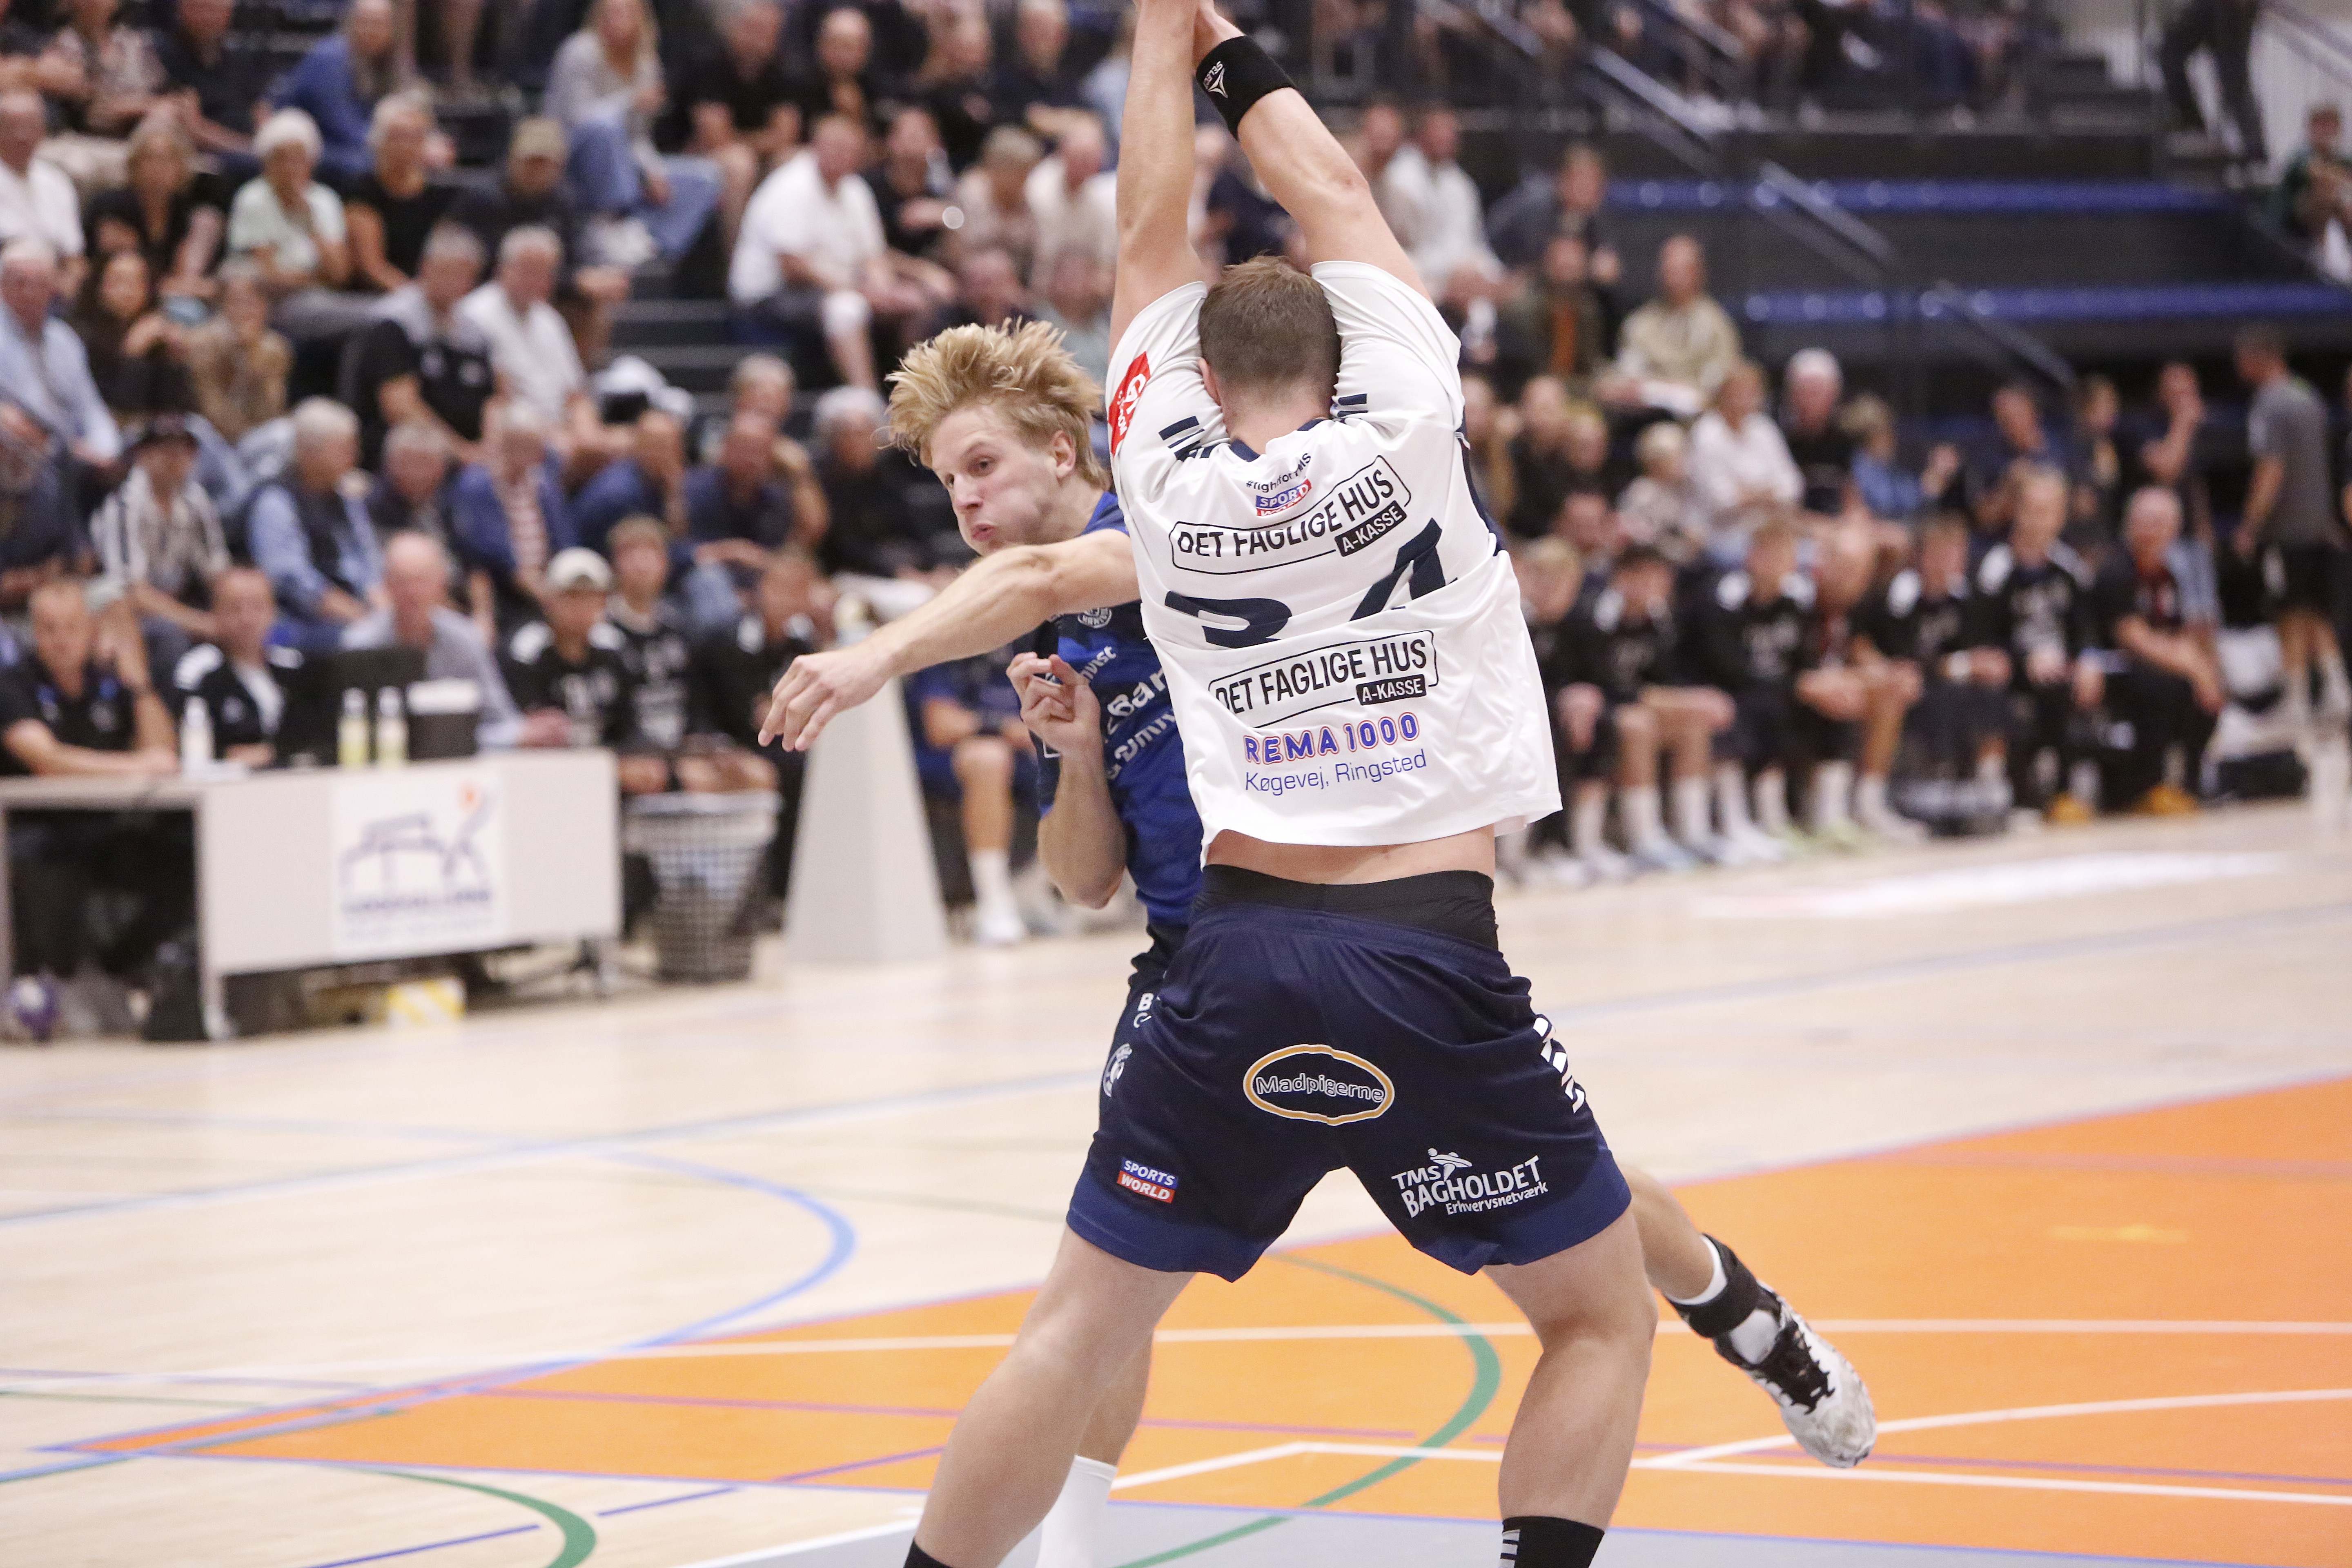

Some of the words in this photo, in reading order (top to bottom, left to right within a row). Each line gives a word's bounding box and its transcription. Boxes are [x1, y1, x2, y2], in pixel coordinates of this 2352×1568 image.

[1178, 531, 1224, 557] DET
[1233, 501, 1343, 556] FAGLIGE
[1338, 469, 1394, 522] HUS
[1342, 506, 1403, 552] A-KASSE
[1215, 678, 1252, 714] DET
[1259, 649, 1366, 705] FAGLIGE
[1370, 639, 1427, 675] HUS
[1361, 678, 1423, 702] A-KASSE
[1243, 727, 1339, 765] REMA
[1343, 712, 1419, 752] 1000
[1245, 766, 1330, 796] Køgevej,
[1335, 748, 1427, 783] Ringsted
[1256, 1072, 1385, 1103] Madpigerne
[1121, 1174, 1170, 1200] WORLD
[1124, 1160, 1176, 1186] SPORTS
[1391, 1165, 1442, 1190] TMS
[1401, 1155, 1539, 1218] BAGHOLDET
[1446, 1181, 1549, 1216] Erhvervsnetværk
